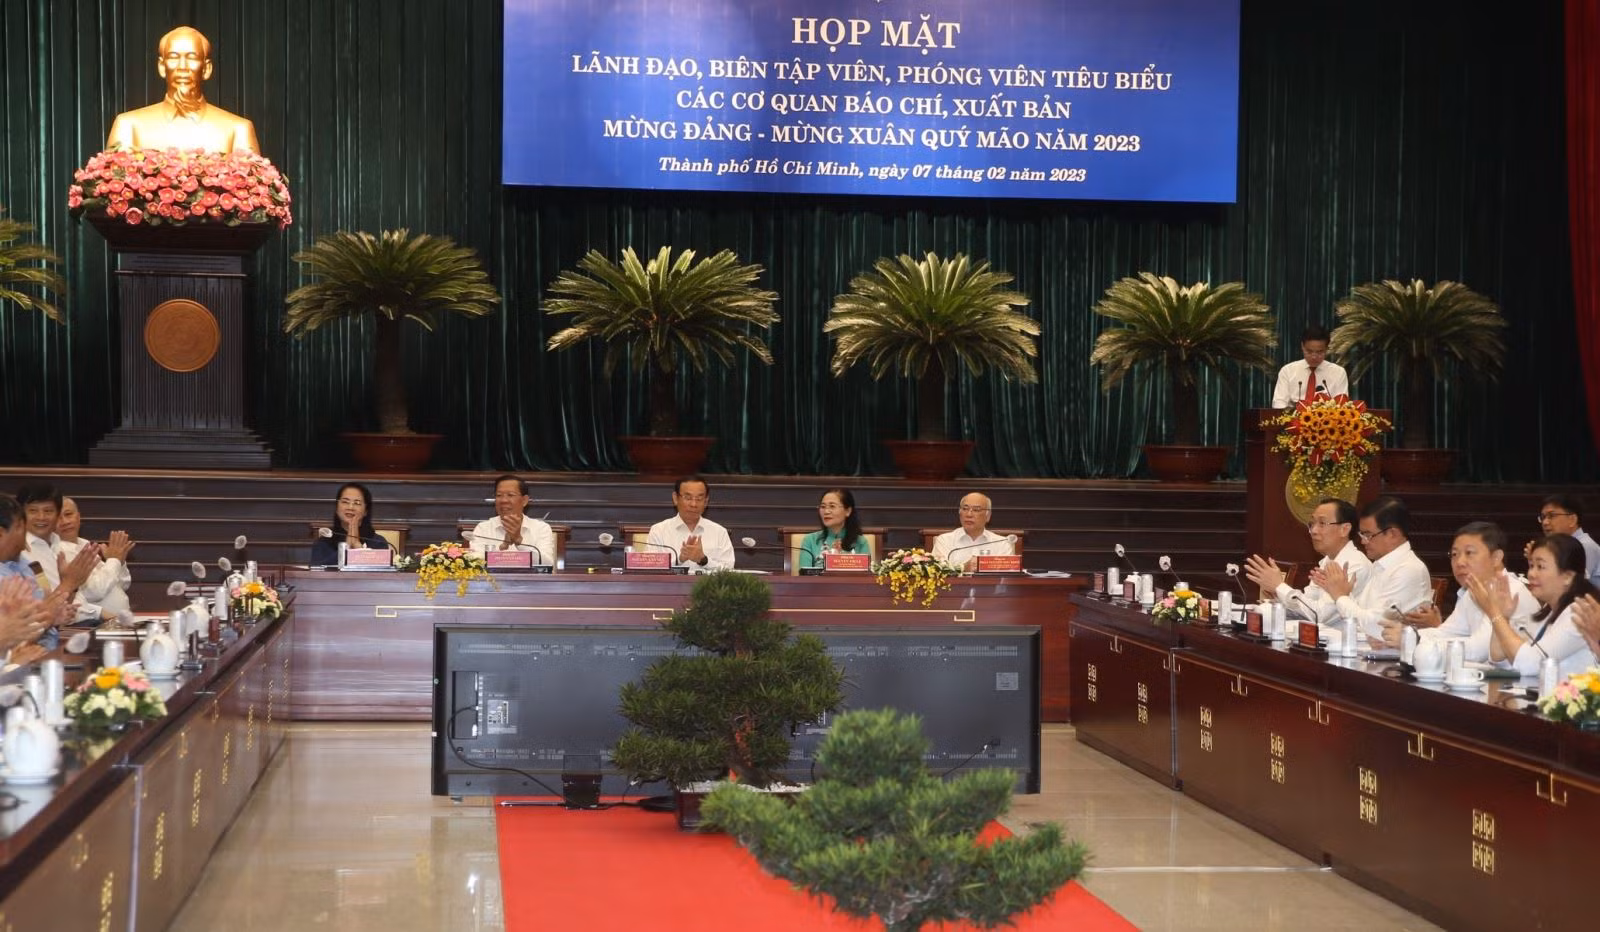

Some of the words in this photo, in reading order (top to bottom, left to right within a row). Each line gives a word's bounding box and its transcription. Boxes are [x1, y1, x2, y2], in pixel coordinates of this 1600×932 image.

[791, 17, 871, 53] HỌP
[880, 13, 961, 56] MẶT
[571, 50, 640, 75] LÃNH
[645, 57, 703, 81] ĐẠO,
[708, 55, 769, 79] BIÊN
[773, 56, 822, 85] TẬP
[825, 58, 892, 87] VIÊN,
[897, 61, 983, 86] PHÓNG
[987, 63, 1047, 88] VIÊN
[1051, 65, 1109, 89] TIÊU
[1113, 63, 1173, 91] BIỂU
[676, 85, 725, 110] CÁC
[731, 90, 765, 111] CƠ
[770, 93, 839, 115] QUAN
[843, 90, 894, 115] BÁO
[899, 93, 949, 120] CHÍ,
[952, 92, 1018, 118] XUẤT
[1022, 94, 1072, 119] BẢN
[602, 114, 678, 140] MỪNG
[682, 115, 753, 142] ĐẢNG
[770, 119, 845, 145] MỪNG
[847, 122, 916, 146] XUÂN
[920, 124, 972, 151] QUÝ
[975, 126, 1030, 150] MÃO
[1034, 127, 1089, 151] NĂM
[1093, 133, 1141, 153] 2023
[658, 156, 714, 173] Thành
[716, 157, 754, 176] phố
[753, 157, 779, 175] Hồ
[782, 160, 813, 176] Chí
[814, 161, 865, 179] Minh,
[867, 163, 910, 181] ngày
[911, 163, 934, 179] 07
[935, 164, 986, 183] tháng
[986, 166, 1007, 180] 02
[1008, 167, 1046, 182] năm
[1048, 167, 1087, 183] 2023
